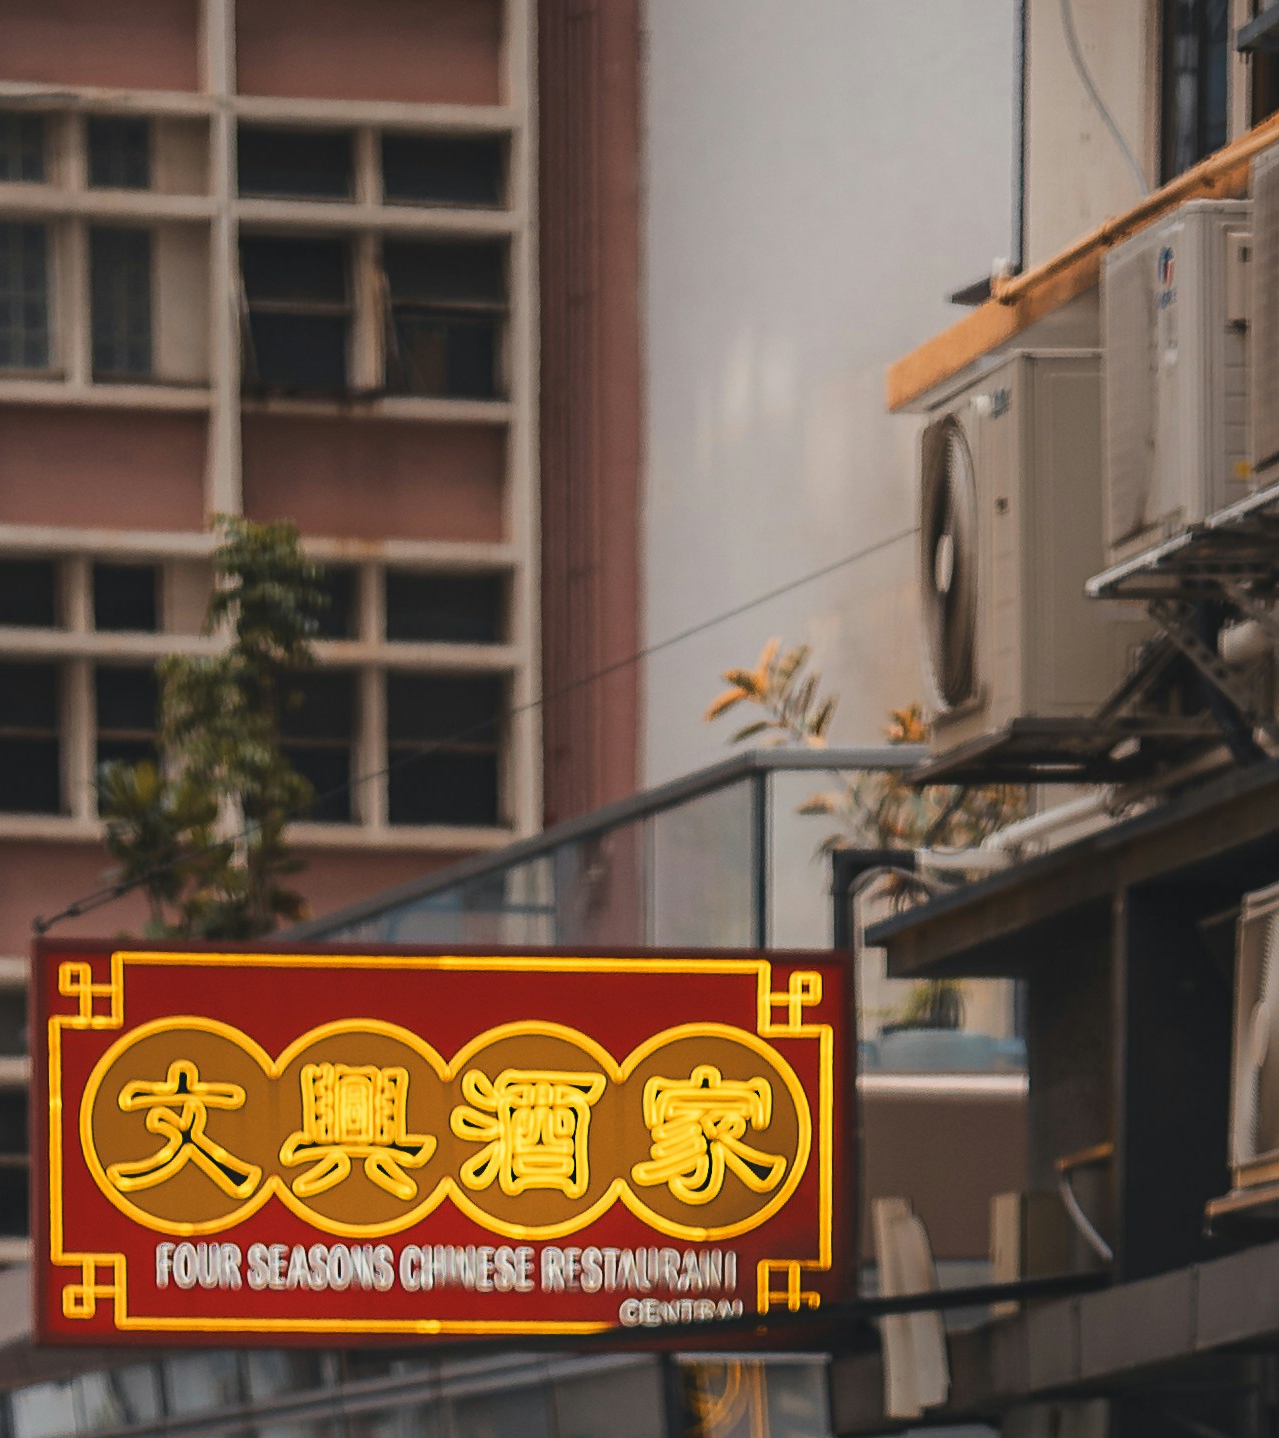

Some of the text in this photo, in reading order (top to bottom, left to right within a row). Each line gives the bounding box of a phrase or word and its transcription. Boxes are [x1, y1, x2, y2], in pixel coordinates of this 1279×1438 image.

[106, 1057, 787, 1205] 文興酒家
[155, 1243, 242, 1292] FOUR
[247, 1244, 394, 1293] SEASONS
[400, 1246, 535, 1293] CHINESE
